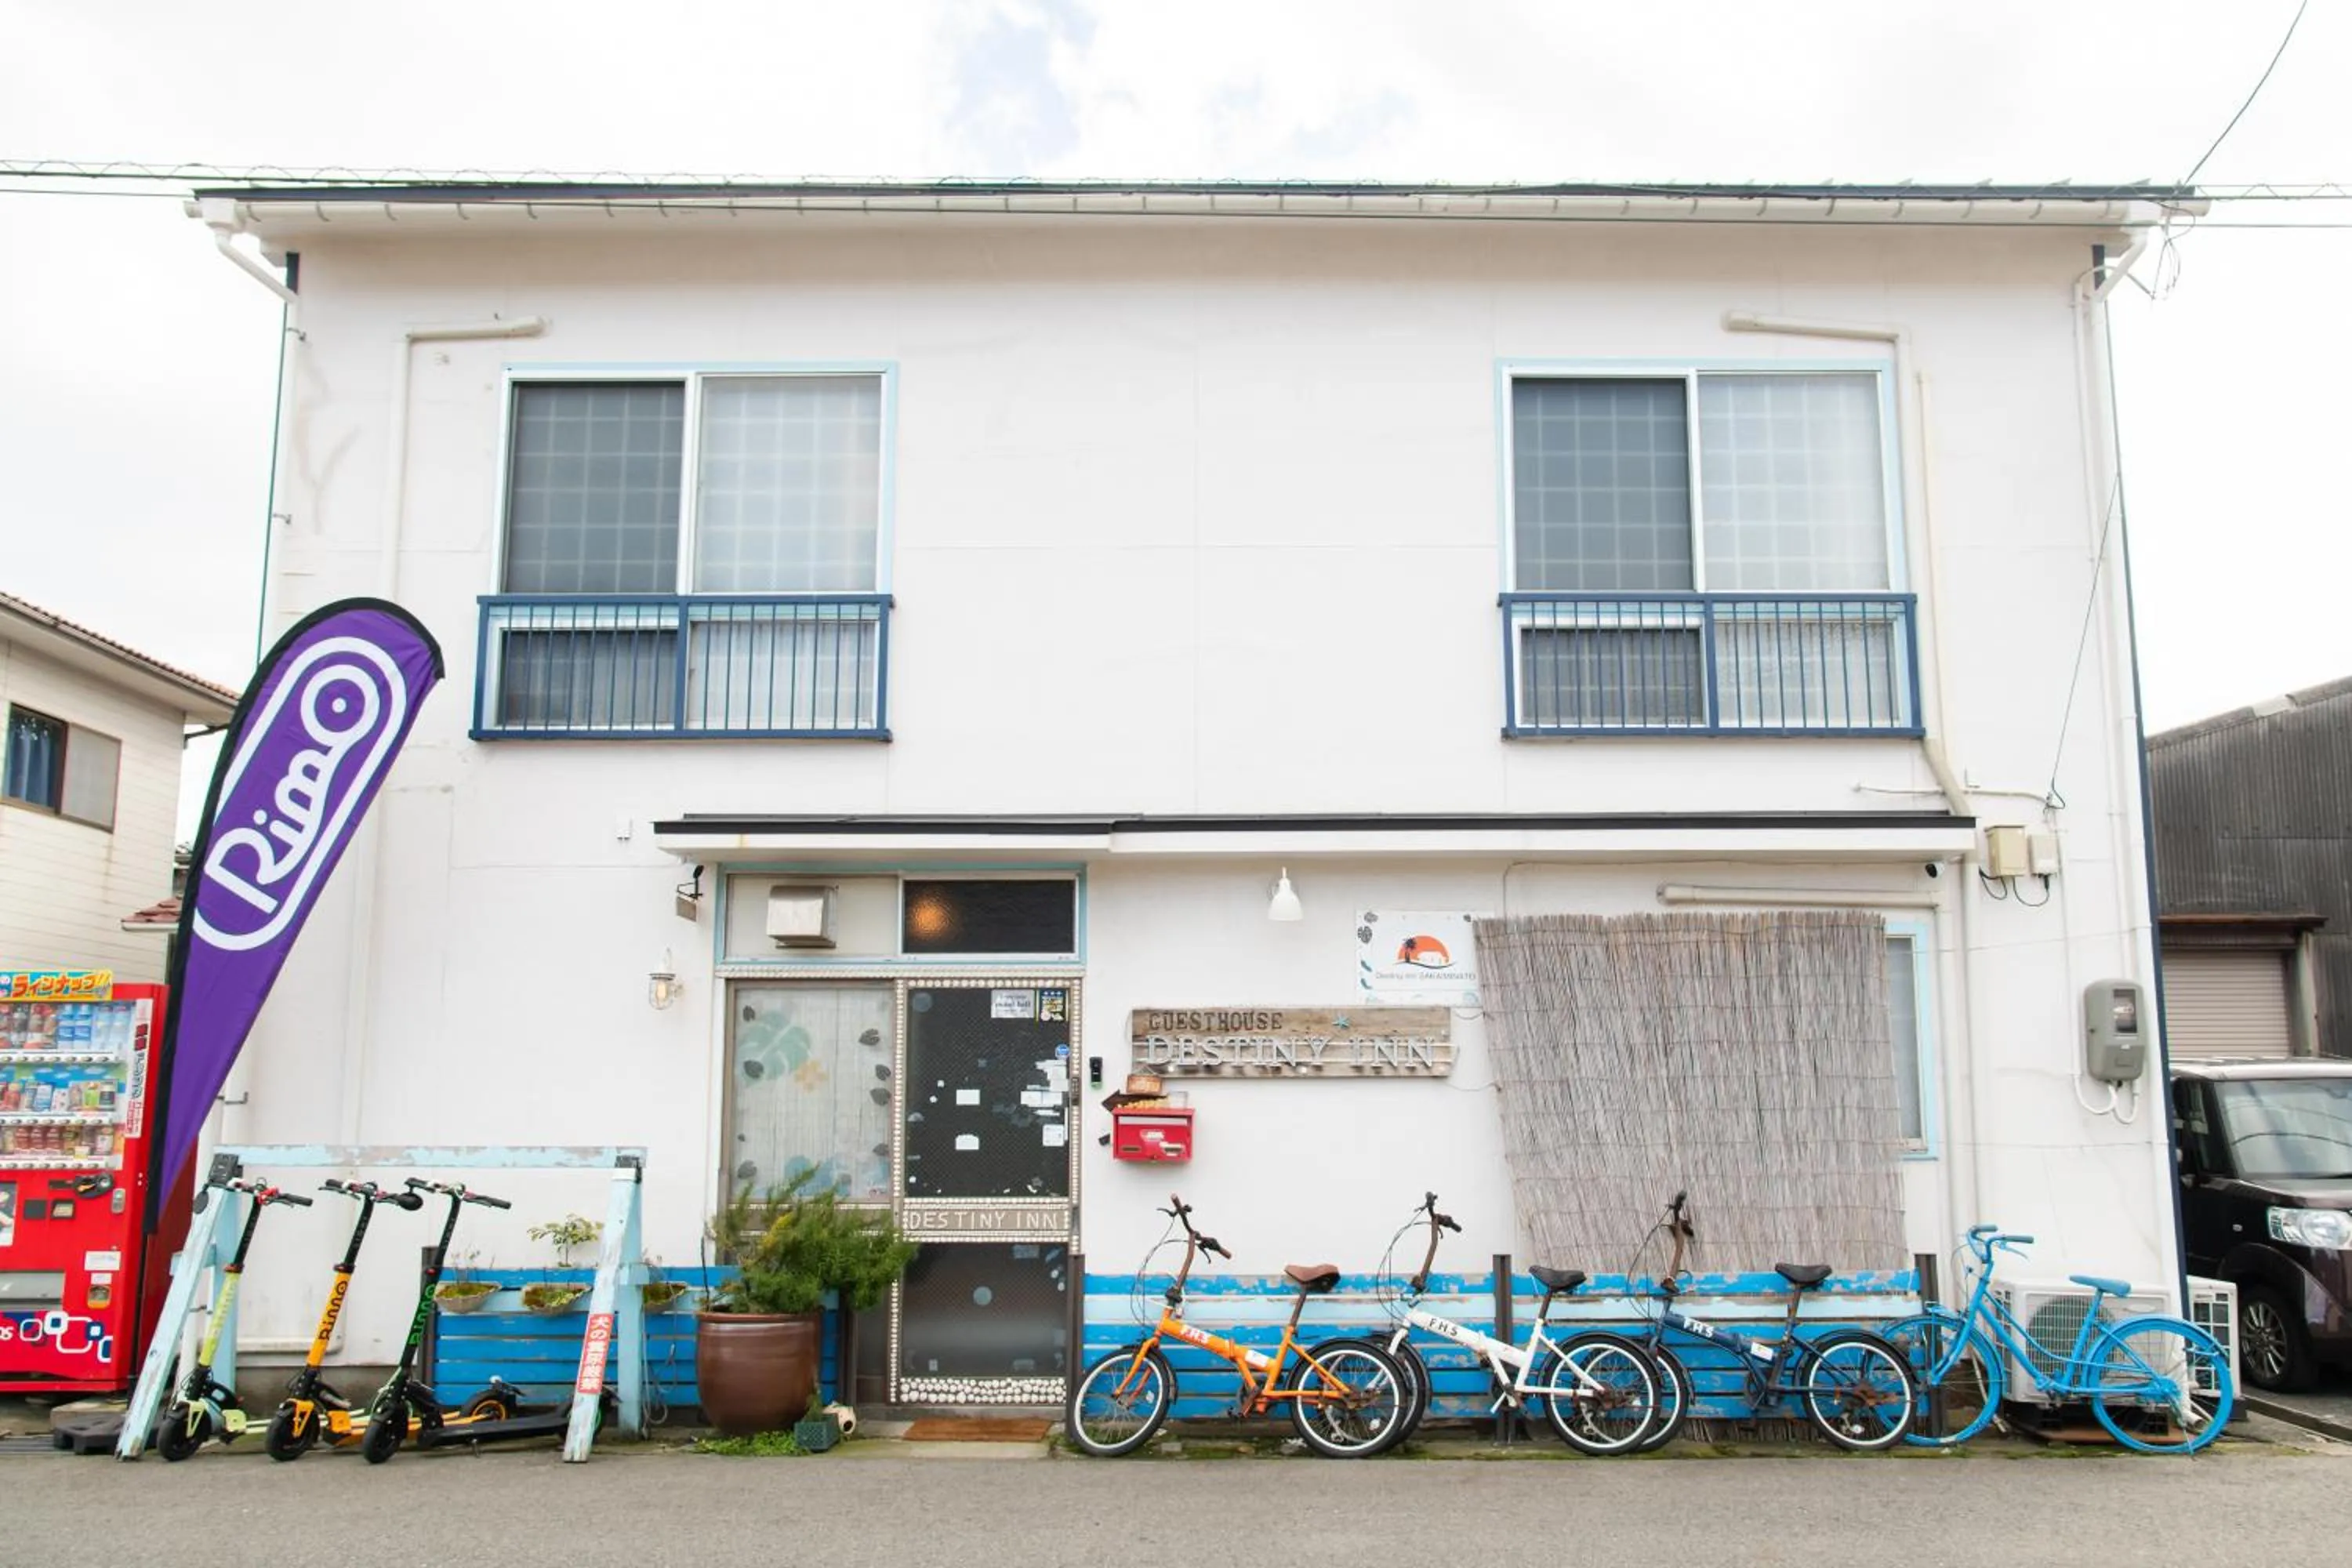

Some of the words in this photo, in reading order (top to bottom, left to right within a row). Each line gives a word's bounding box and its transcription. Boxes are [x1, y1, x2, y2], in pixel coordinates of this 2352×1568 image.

[204, 664, 380, 914] Rimo
[1149, 1011, 1283, 1033] GUESTHOUSE
[1145, 1036, 1330, 1067] DESTINY
[1351, 1036, 1436, 1069] INN
[909, 1210, 1006, 1229] DESTINY
[1016, 1211, 1057, 1229] INN
